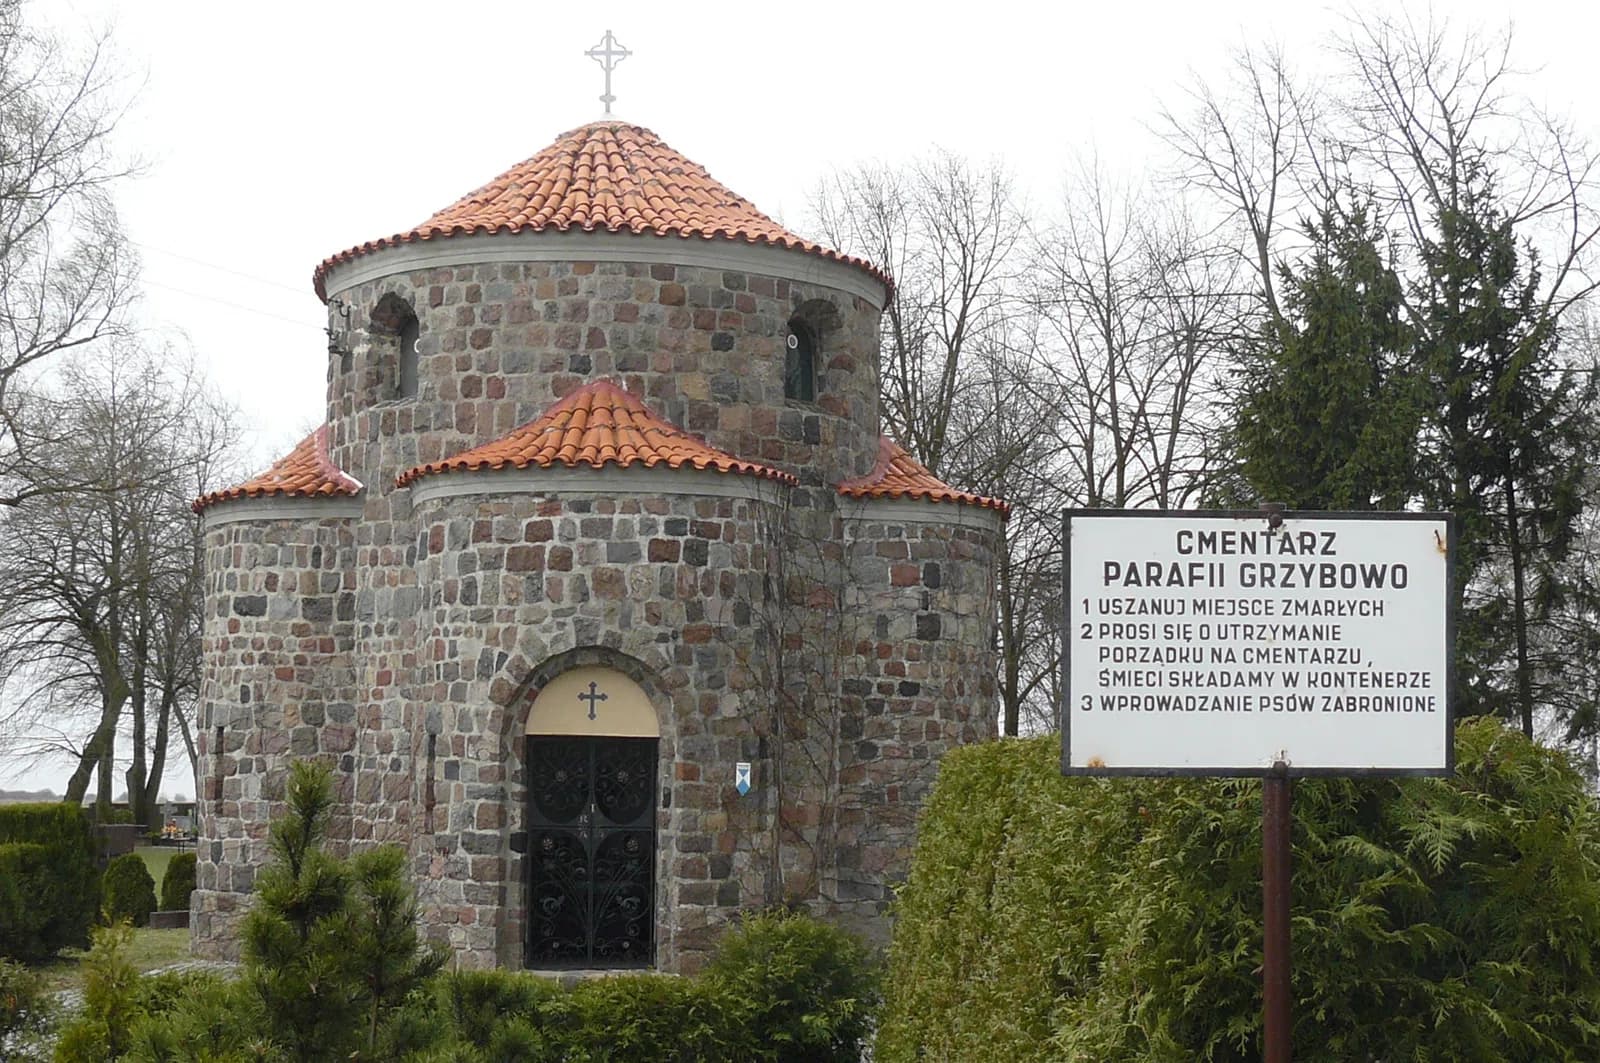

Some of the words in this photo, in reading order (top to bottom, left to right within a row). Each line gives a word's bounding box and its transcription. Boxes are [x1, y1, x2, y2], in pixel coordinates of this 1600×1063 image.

[1176, 530, 1337, 556] CMENTARZ
[1103, 561, 1225, 588] PARAFII
[1239, 562, 1408, 590] GRZYBOWO
[1082, 598, 1089, 615] 1
[1098, 598, 1186, 616] USZANUJ
[1192, 598, 1275, 617] MIEJSCE
[1281, 599, 1384, 617] ZMARŁYCH
[1080, 622, 1093, 640] 2
[1099, 623, 1156, 641] PROSI
[1163, 623, 1193, 643] SIĘ
[1199, 623, 1211, 641] O
[1217, 623, 1341, 641] UTRZYMANIE
[1210, 647, 1237, 664] NA
[1098, 668, 1163, 688] ŚMIECI
[1168, 670, 1275, 688] SKŁADAMY
[1281, 671, 1300, 688] W
[1307, 671, 1431, 689] KONTENERZE
[1081, 694, 1093, 712] 3
[1100, 695, 1253, 712] WPROWADZANIE
[1259, 693, 1315, 713] PSÓW
[1321, 695, 1436, 713] ZABRONIONE
